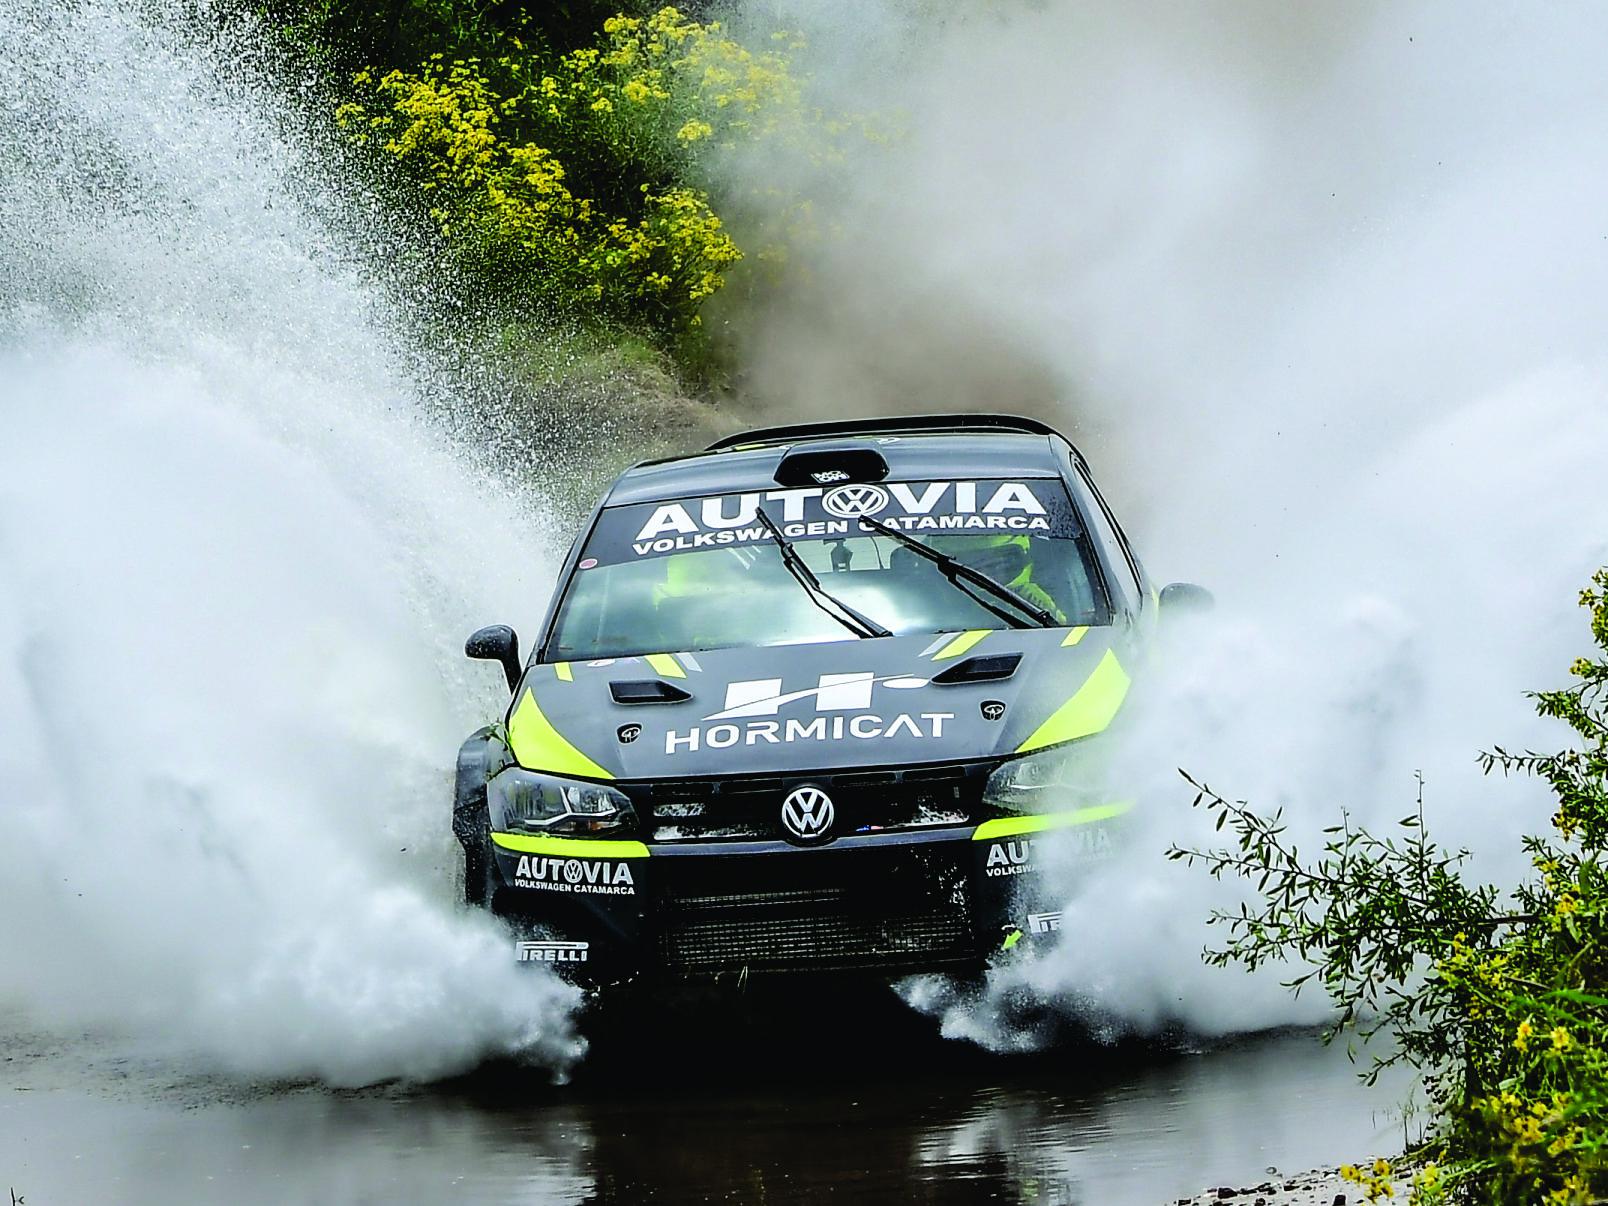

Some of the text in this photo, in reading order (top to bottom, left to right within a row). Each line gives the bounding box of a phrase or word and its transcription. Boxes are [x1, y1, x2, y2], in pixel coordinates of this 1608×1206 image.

[635, 482, 1047, 540] AUTOVIA
[665, 713, 955, 754] HORMICAT
[515, 878, 635, 895] VOLKSWAGEN CATAMARCA
[516, 855, 634, 885] AUTOVIA
